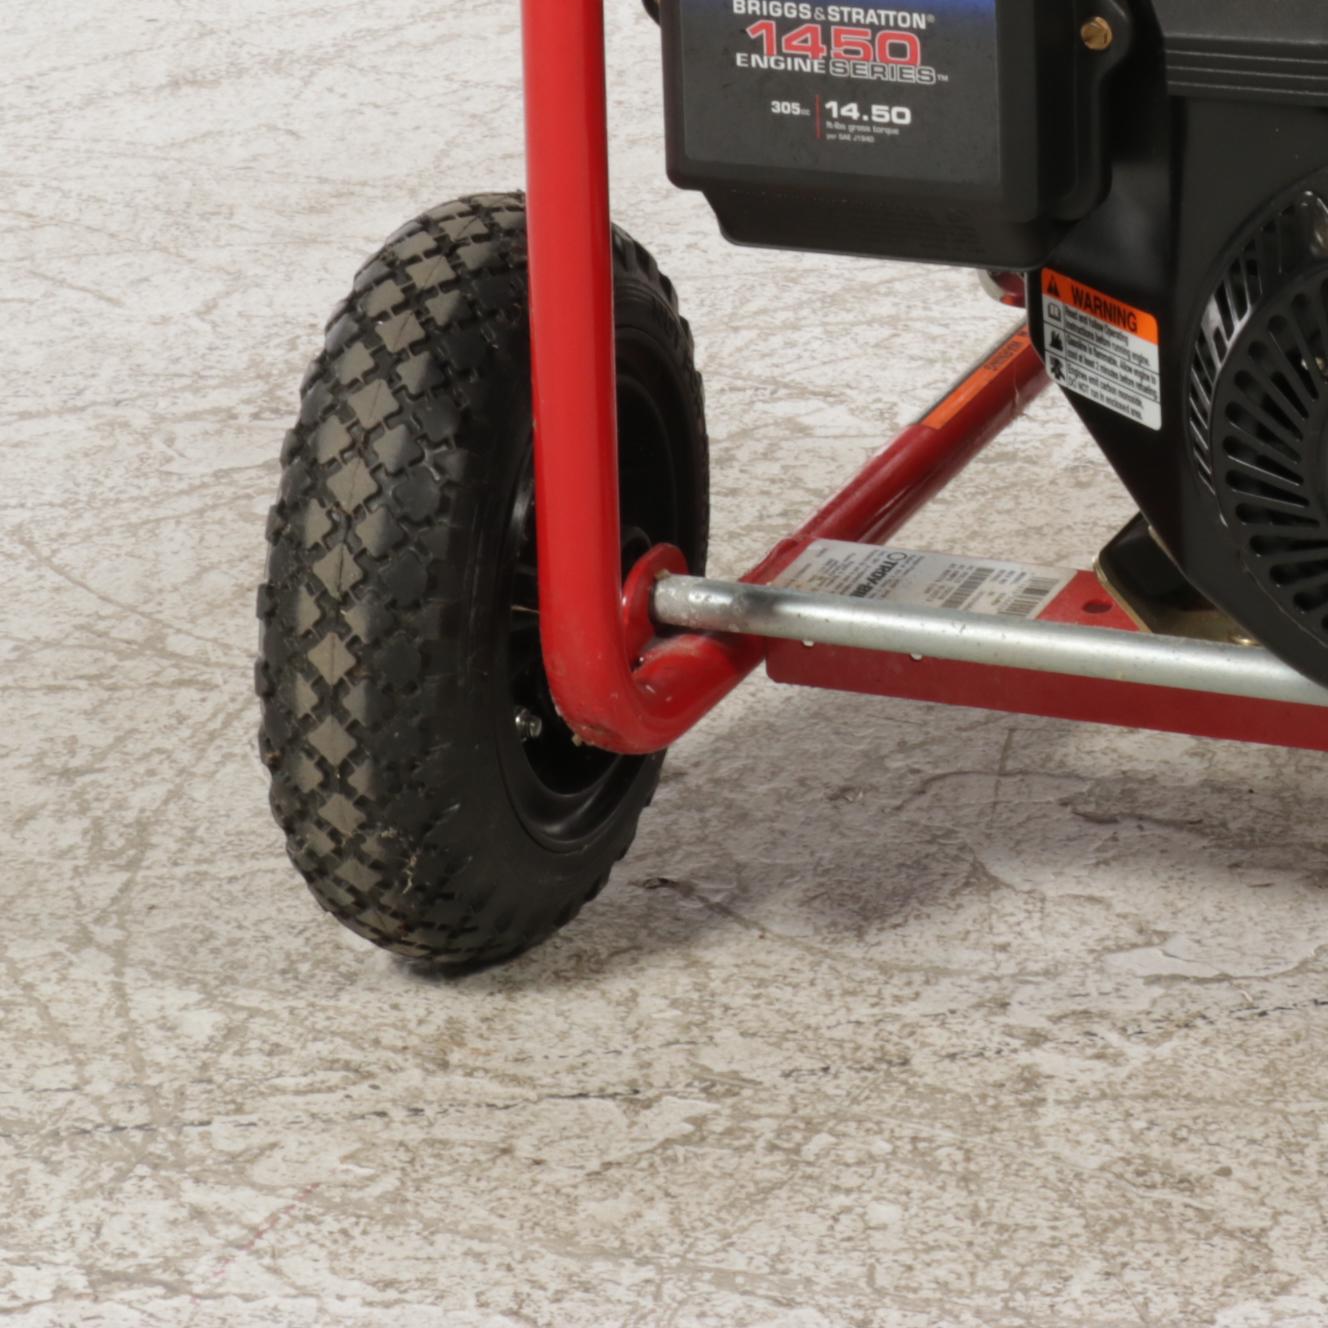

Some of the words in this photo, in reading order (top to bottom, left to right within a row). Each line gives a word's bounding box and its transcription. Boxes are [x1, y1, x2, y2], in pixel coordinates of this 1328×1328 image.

[746, 19, 921, 66] 1450
[736, 52, 826, 74] ENGINE
[829, 59, 936, 85] SERIES
[825, 100, 912, 125] 14.50
[1072, 287, 1137, 331] WARNING
[849, 560, 899, 598] TROY-BIL
